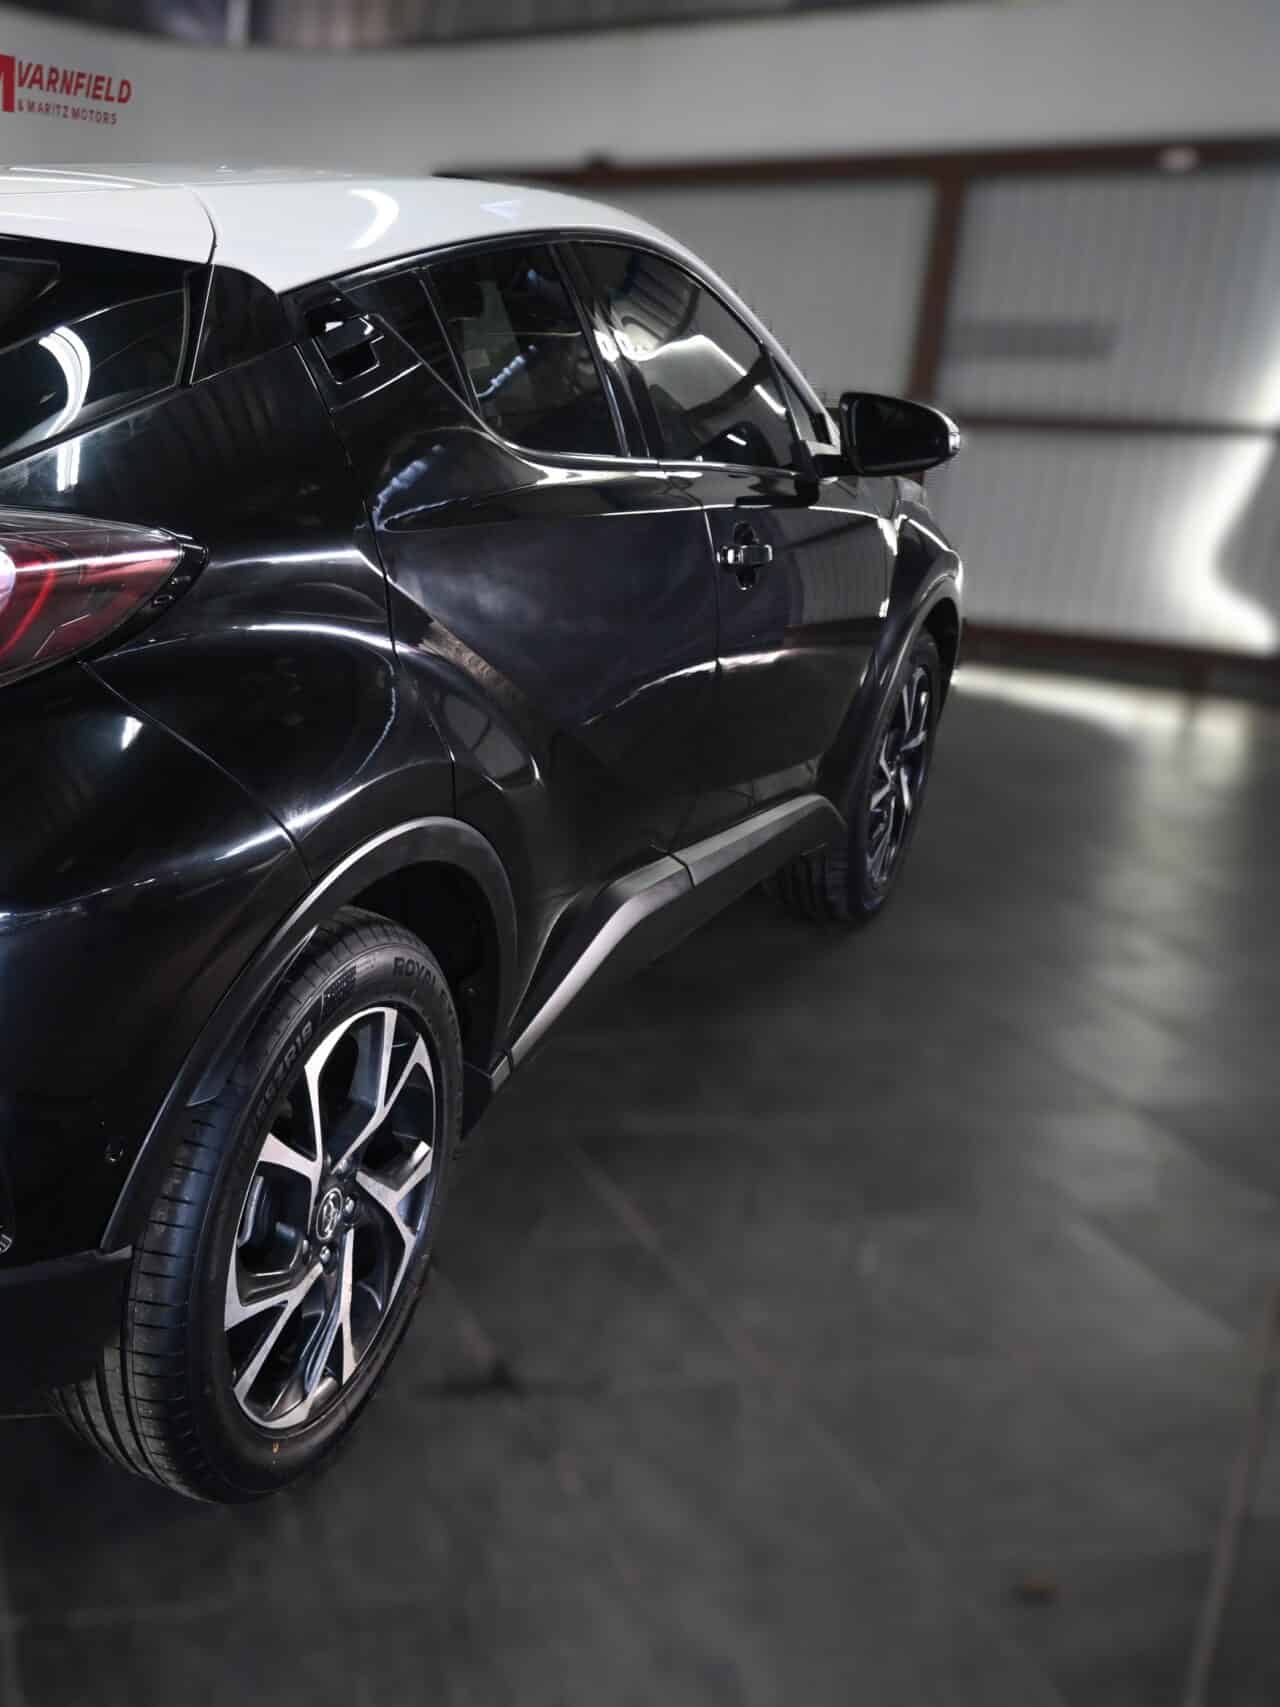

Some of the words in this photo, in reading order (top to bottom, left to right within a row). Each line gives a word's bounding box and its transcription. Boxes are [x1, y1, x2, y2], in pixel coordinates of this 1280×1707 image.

[17, 61, 133, 105] VARNFIELD
[27, 100, 69, 119] MARITZ
[71, 106, 118, 126] MOTORS
